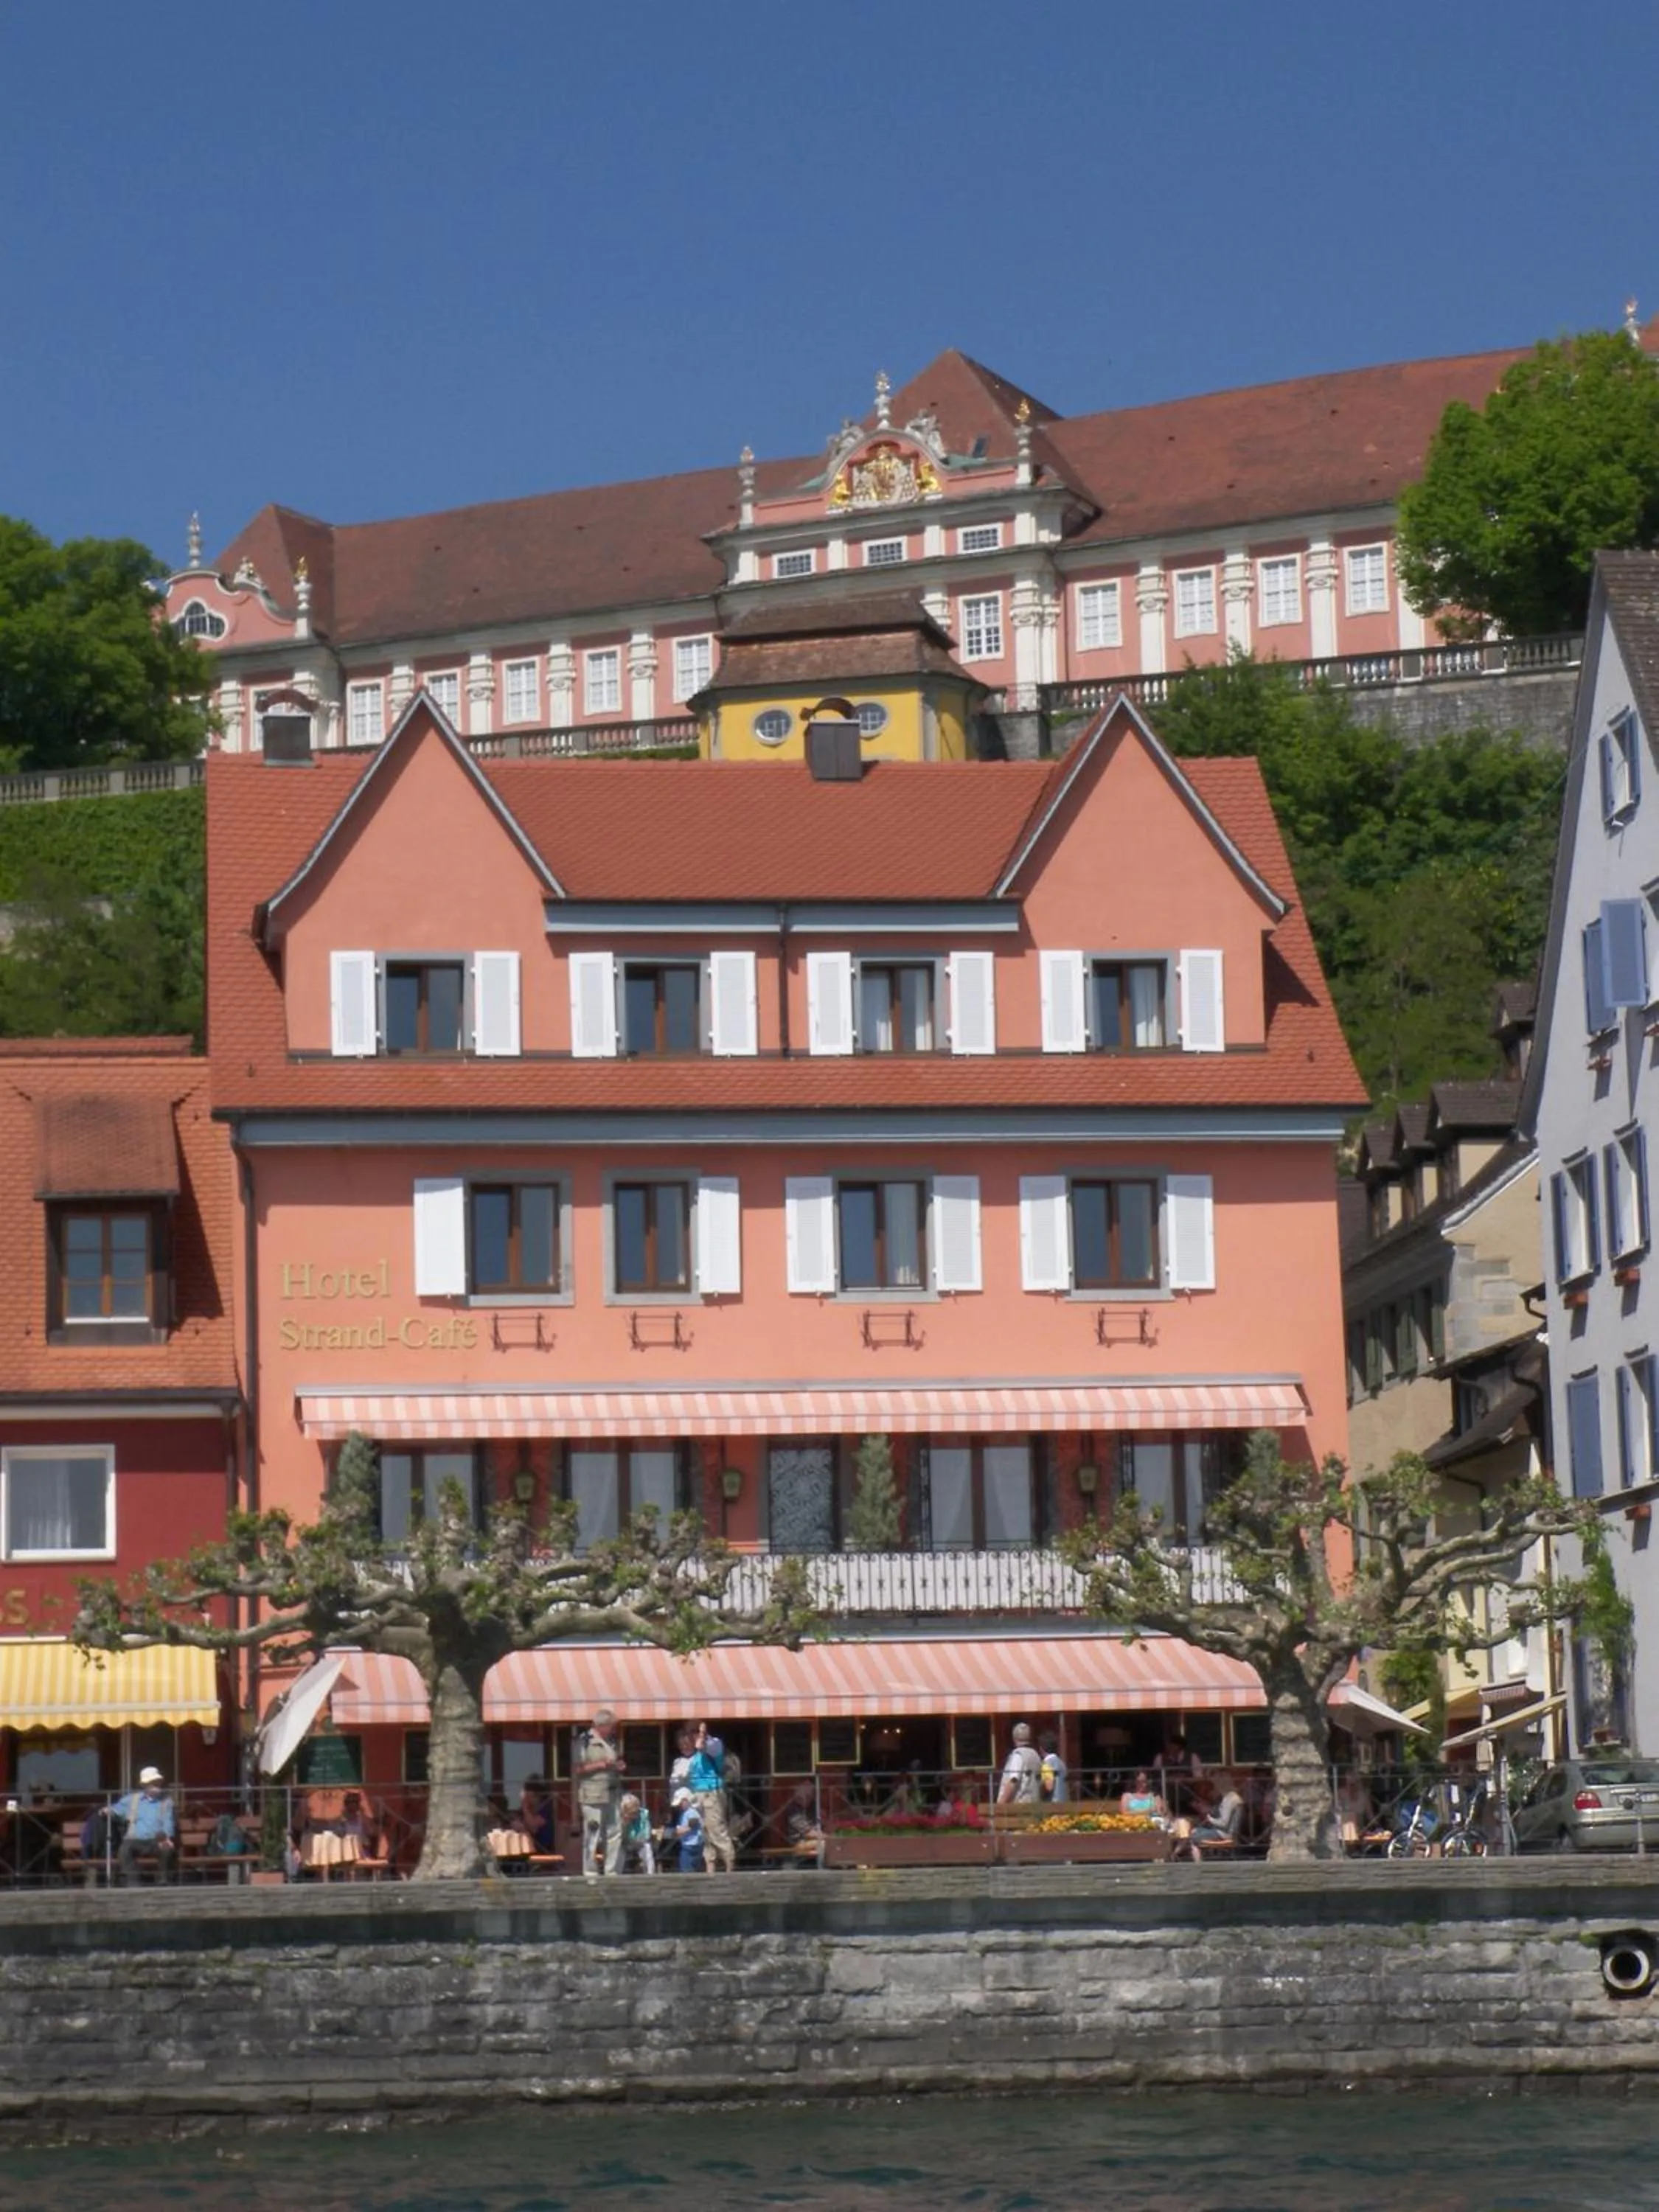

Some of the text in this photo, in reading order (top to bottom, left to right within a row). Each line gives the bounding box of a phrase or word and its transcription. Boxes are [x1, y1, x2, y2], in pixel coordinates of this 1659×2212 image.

[279, 1258, 392, 1300] Hotel
[279, 1315, 479, 1351] Strand-Café
[0, 1589, 29, 1624] S
